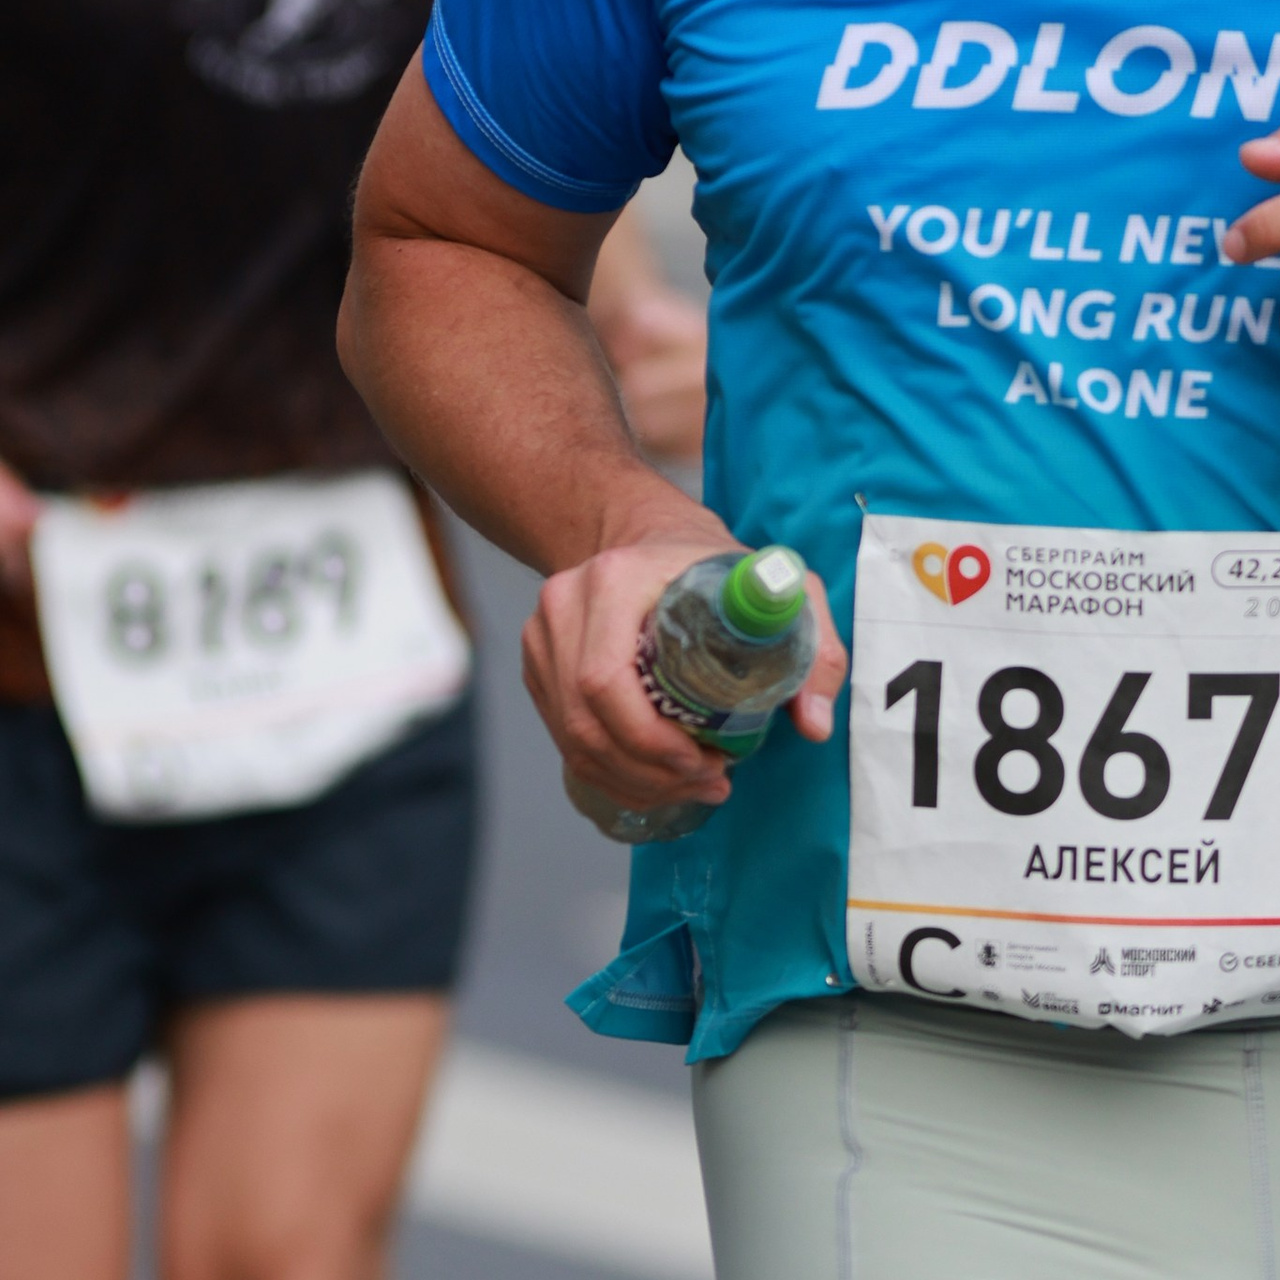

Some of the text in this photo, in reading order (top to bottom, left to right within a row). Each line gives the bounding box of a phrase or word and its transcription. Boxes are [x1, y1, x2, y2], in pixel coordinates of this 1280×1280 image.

[867, 204, 1101, 263] YOU'LL
[937, 282, 1275, 345] LONG RUN
[1004, 361, 1213, 419] ALONE
[1005, 545, 1145, 567] СБЕРПРАЙМ
[1005, 567, 1195, 593] МОСКОВСКИЙ
[1005, 592, 1144, 617] МАРАФОН
[1022, 839, 1221, 885] АЛЕКСЕЙ
[1121, 945, 1196, 962] МОСКОВСКИЙ
